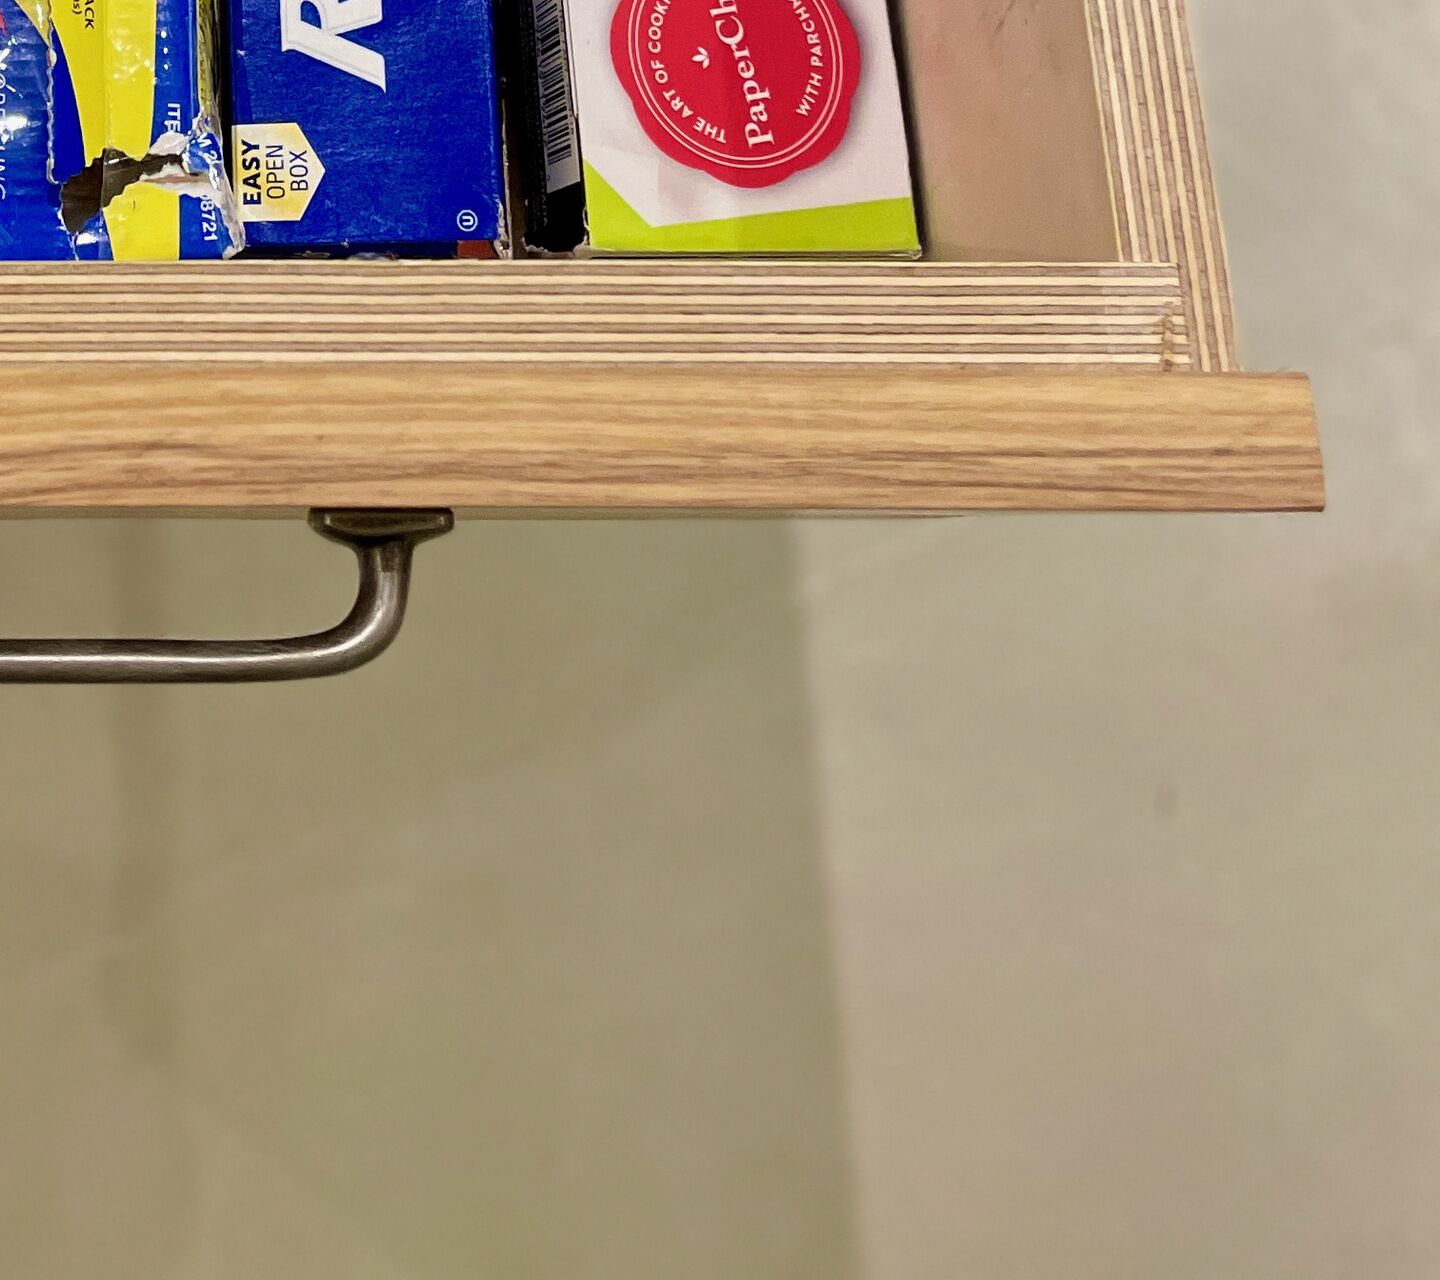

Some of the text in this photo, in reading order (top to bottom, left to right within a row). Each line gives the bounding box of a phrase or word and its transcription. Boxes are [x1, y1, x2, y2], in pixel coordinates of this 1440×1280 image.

[651, 59, 669, 84] OF
[663, 87, 694, 119] ART
[795, 73, 823, 117] WITH
[692, 116, 727, 144] THE
[242, 139, 262, 206] EASY
[265, 144, 285, 199] OPEN
[290, 149, 309, 193] BOX
[200, 195, 217, 242] 8721
